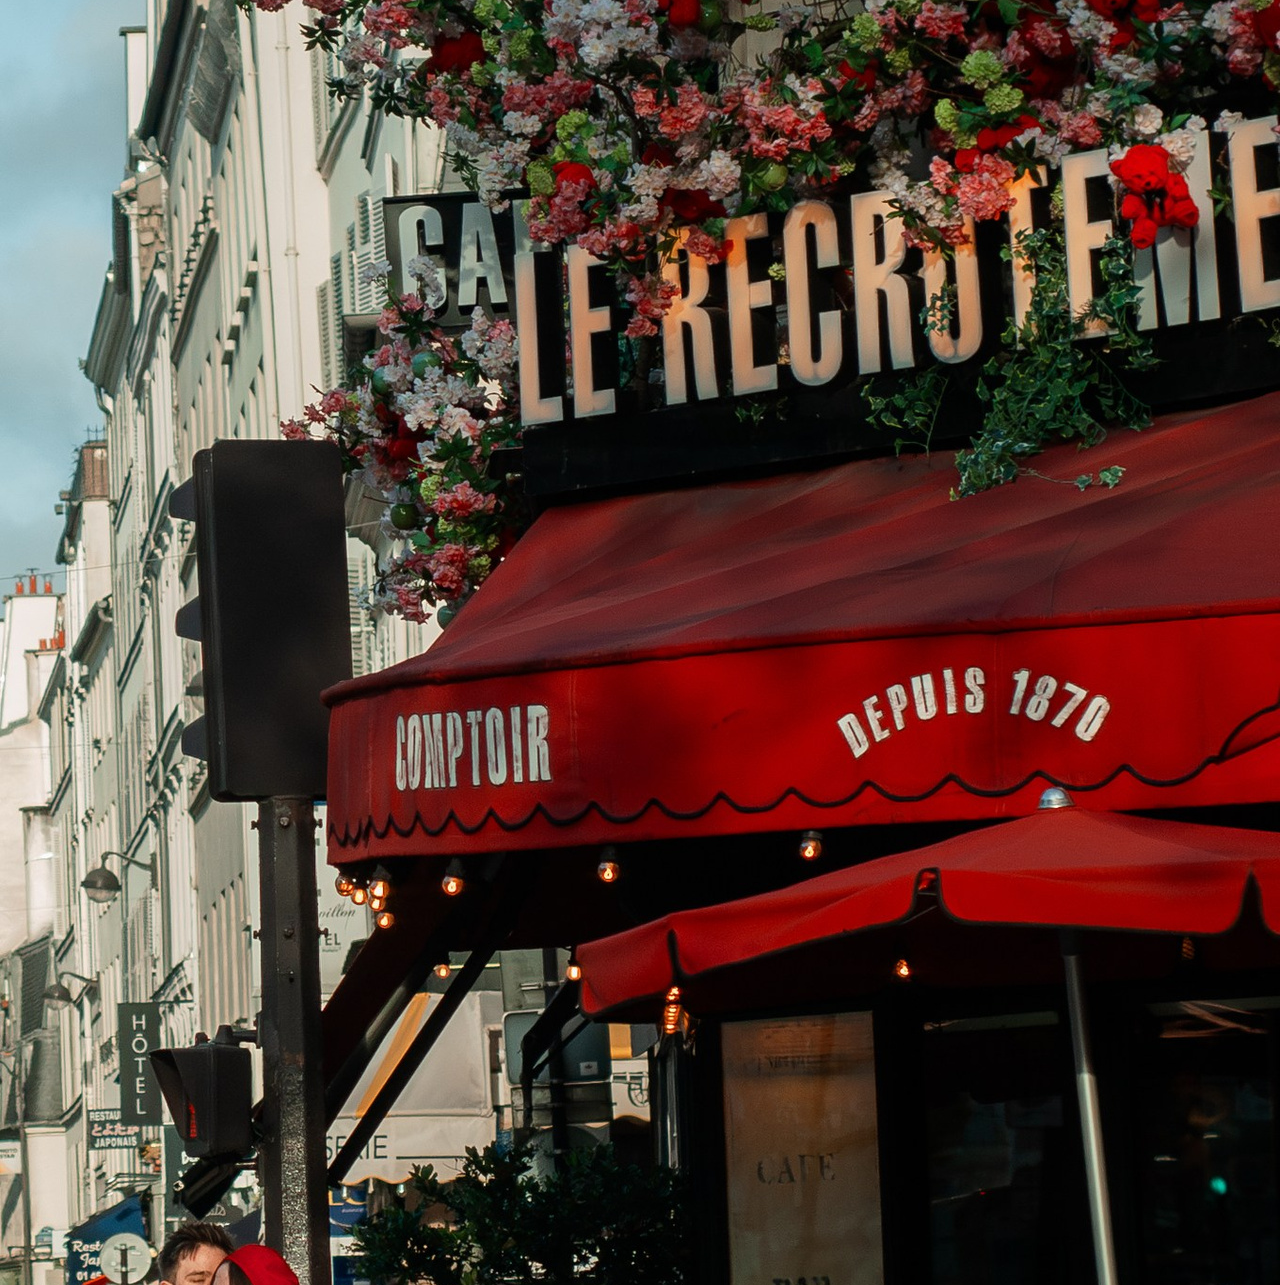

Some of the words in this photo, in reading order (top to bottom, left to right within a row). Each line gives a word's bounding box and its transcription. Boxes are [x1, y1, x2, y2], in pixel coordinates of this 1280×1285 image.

[520, 243, 616, 425] LE
[395, 704, 553, 792] COMPTOIR
[837, 666, 986, 760] DEPUIS
[1008, 668, 1111, 743] 1870
[131, 1014, 148, 1115] HÔTEL
[94, 1137, 138, 1148] JAPONAIS
